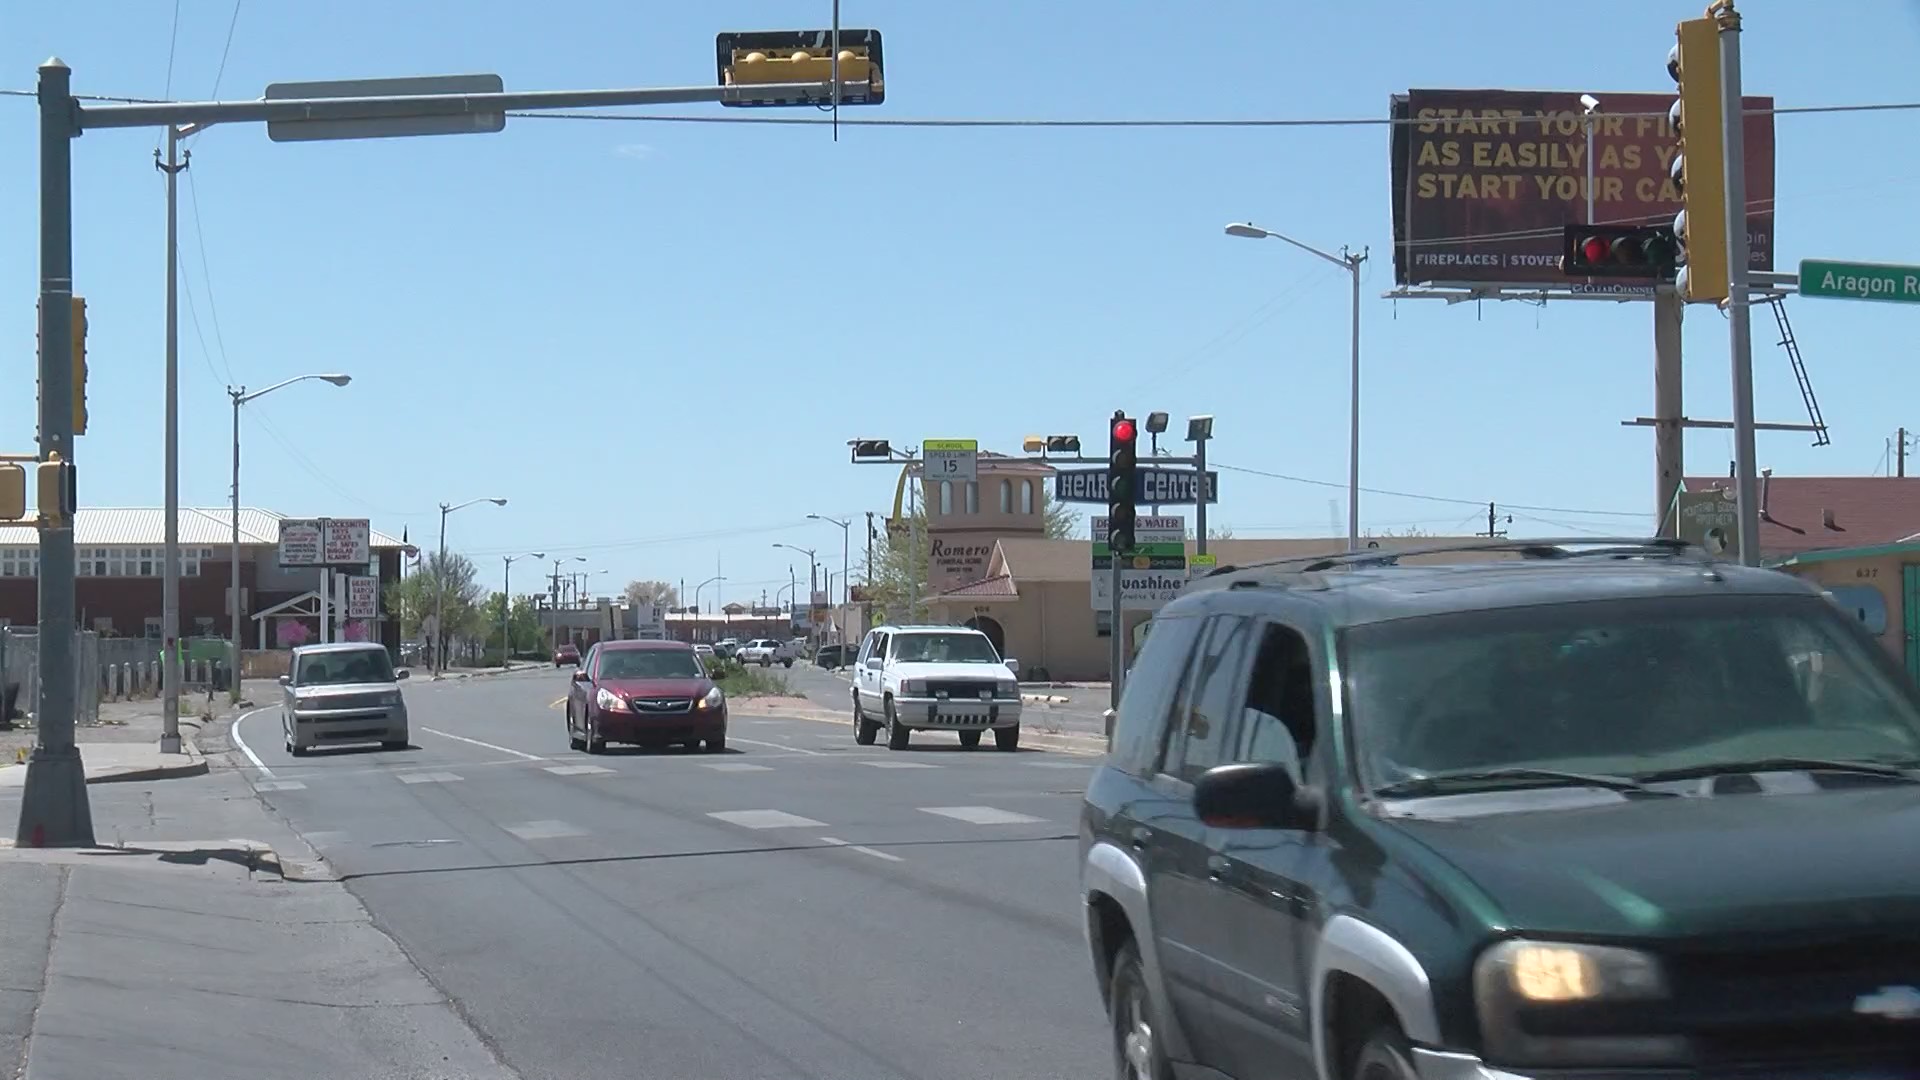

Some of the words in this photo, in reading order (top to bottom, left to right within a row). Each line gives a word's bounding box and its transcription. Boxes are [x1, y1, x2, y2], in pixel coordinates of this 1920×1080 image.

[1417, 107, 1523, 135] START
[1535, 110, 1624, 138] YOUR
[1416, 140, 1461, 167] AS
[1472, 141, 1587, 169] EASILY
[1600, 144, 1642, 170] AS
[1654, 145, 1681, 170] Y
[1416, 173, 1523, 200] START
[1534, 174, 1624, 202] YOUR
[1635, 176, 1683, 203] CA
[1415, 253, 1499, 266] FIREPLACES
[1510, 254, 1560, 267] STOVES
[1821, 270, 1896, 297] Aragon
[1903, 274, 1920, 295] R
[936, 442, 964, 450] SCHOOL
[929, 451, 952, 459] SPEED
[954, 451, 972, 459] LIMIT
[943, 459, 958, 473] 15
[1061, 472, 1110, 500] HENR
[326, 520, 368, 529] LOCKSMITH
[1145, 518, 1178, 529] WATER
[930, 538, 990, 557] Romero
[1121, 575, 1182, 590] unshine
[351, 607, 374, 615] CENTER
